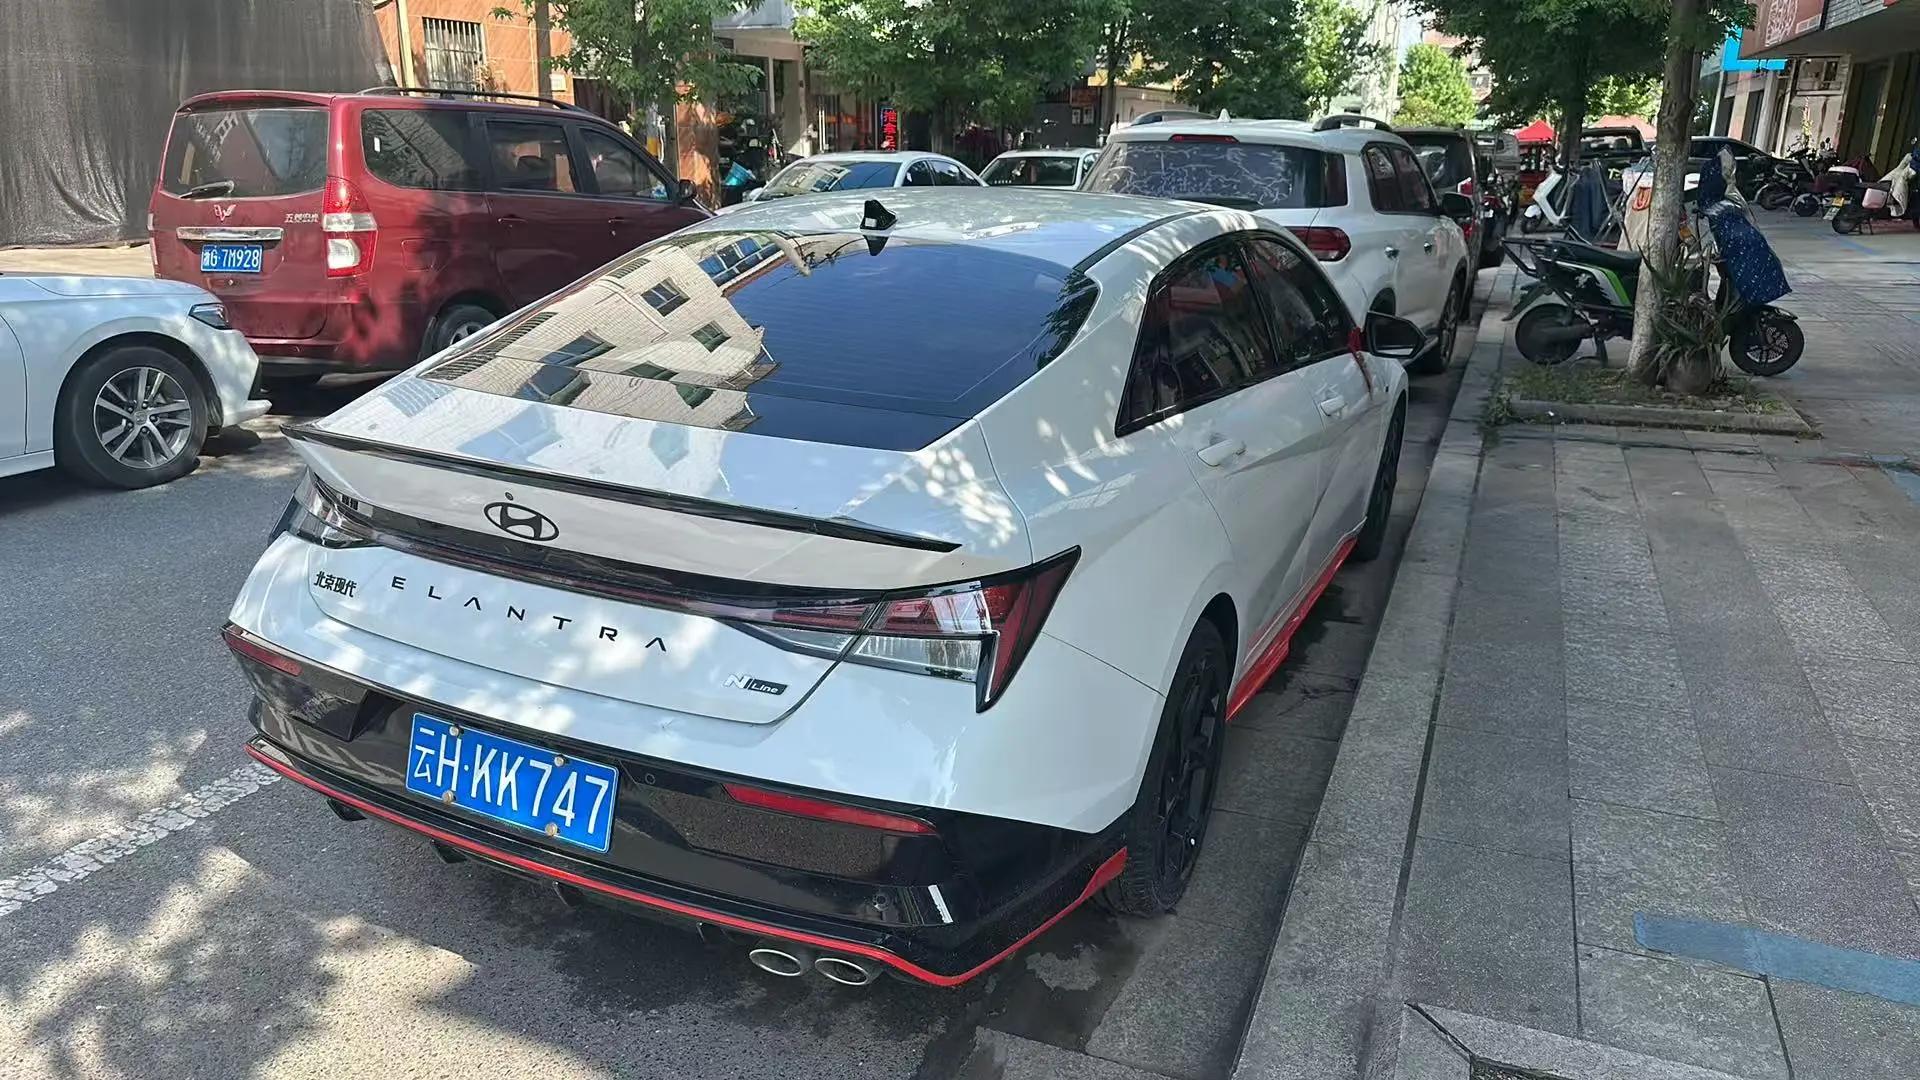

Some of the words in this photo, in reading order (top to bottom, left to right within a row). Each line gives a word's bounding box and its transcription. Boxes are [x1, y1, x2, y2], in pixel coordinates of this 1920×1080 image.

[883, 110, 897, 151] 推拿足
[313, 571, 357, 597] 北京现代
[391, 576, 666, 652] ELANTRA
[723, 674, 752, 689] N
[751, 683, 779, 693] Line
[414, 728, 609, 834] 云H·KK747
